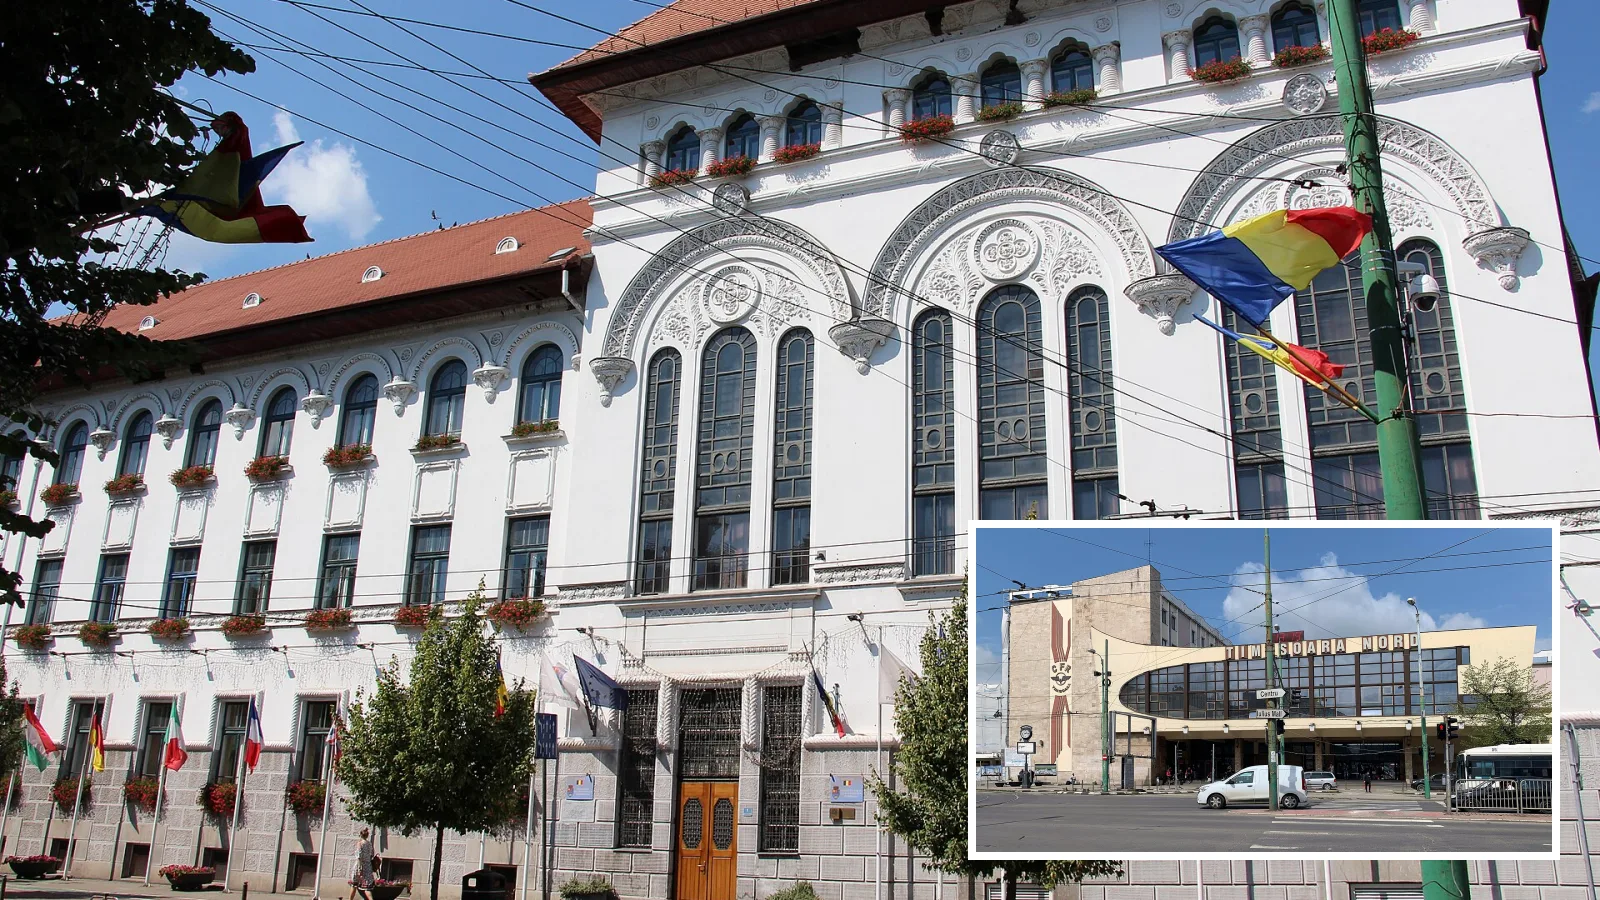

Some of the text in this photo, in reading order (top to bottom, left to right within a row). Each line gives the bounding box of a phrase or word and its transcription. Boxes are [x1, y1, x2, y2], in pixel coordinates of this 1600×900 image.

[1226, 633, 1419, 659] TIMSOARA NORD
[1051, 662, 1072, 674] CFR
